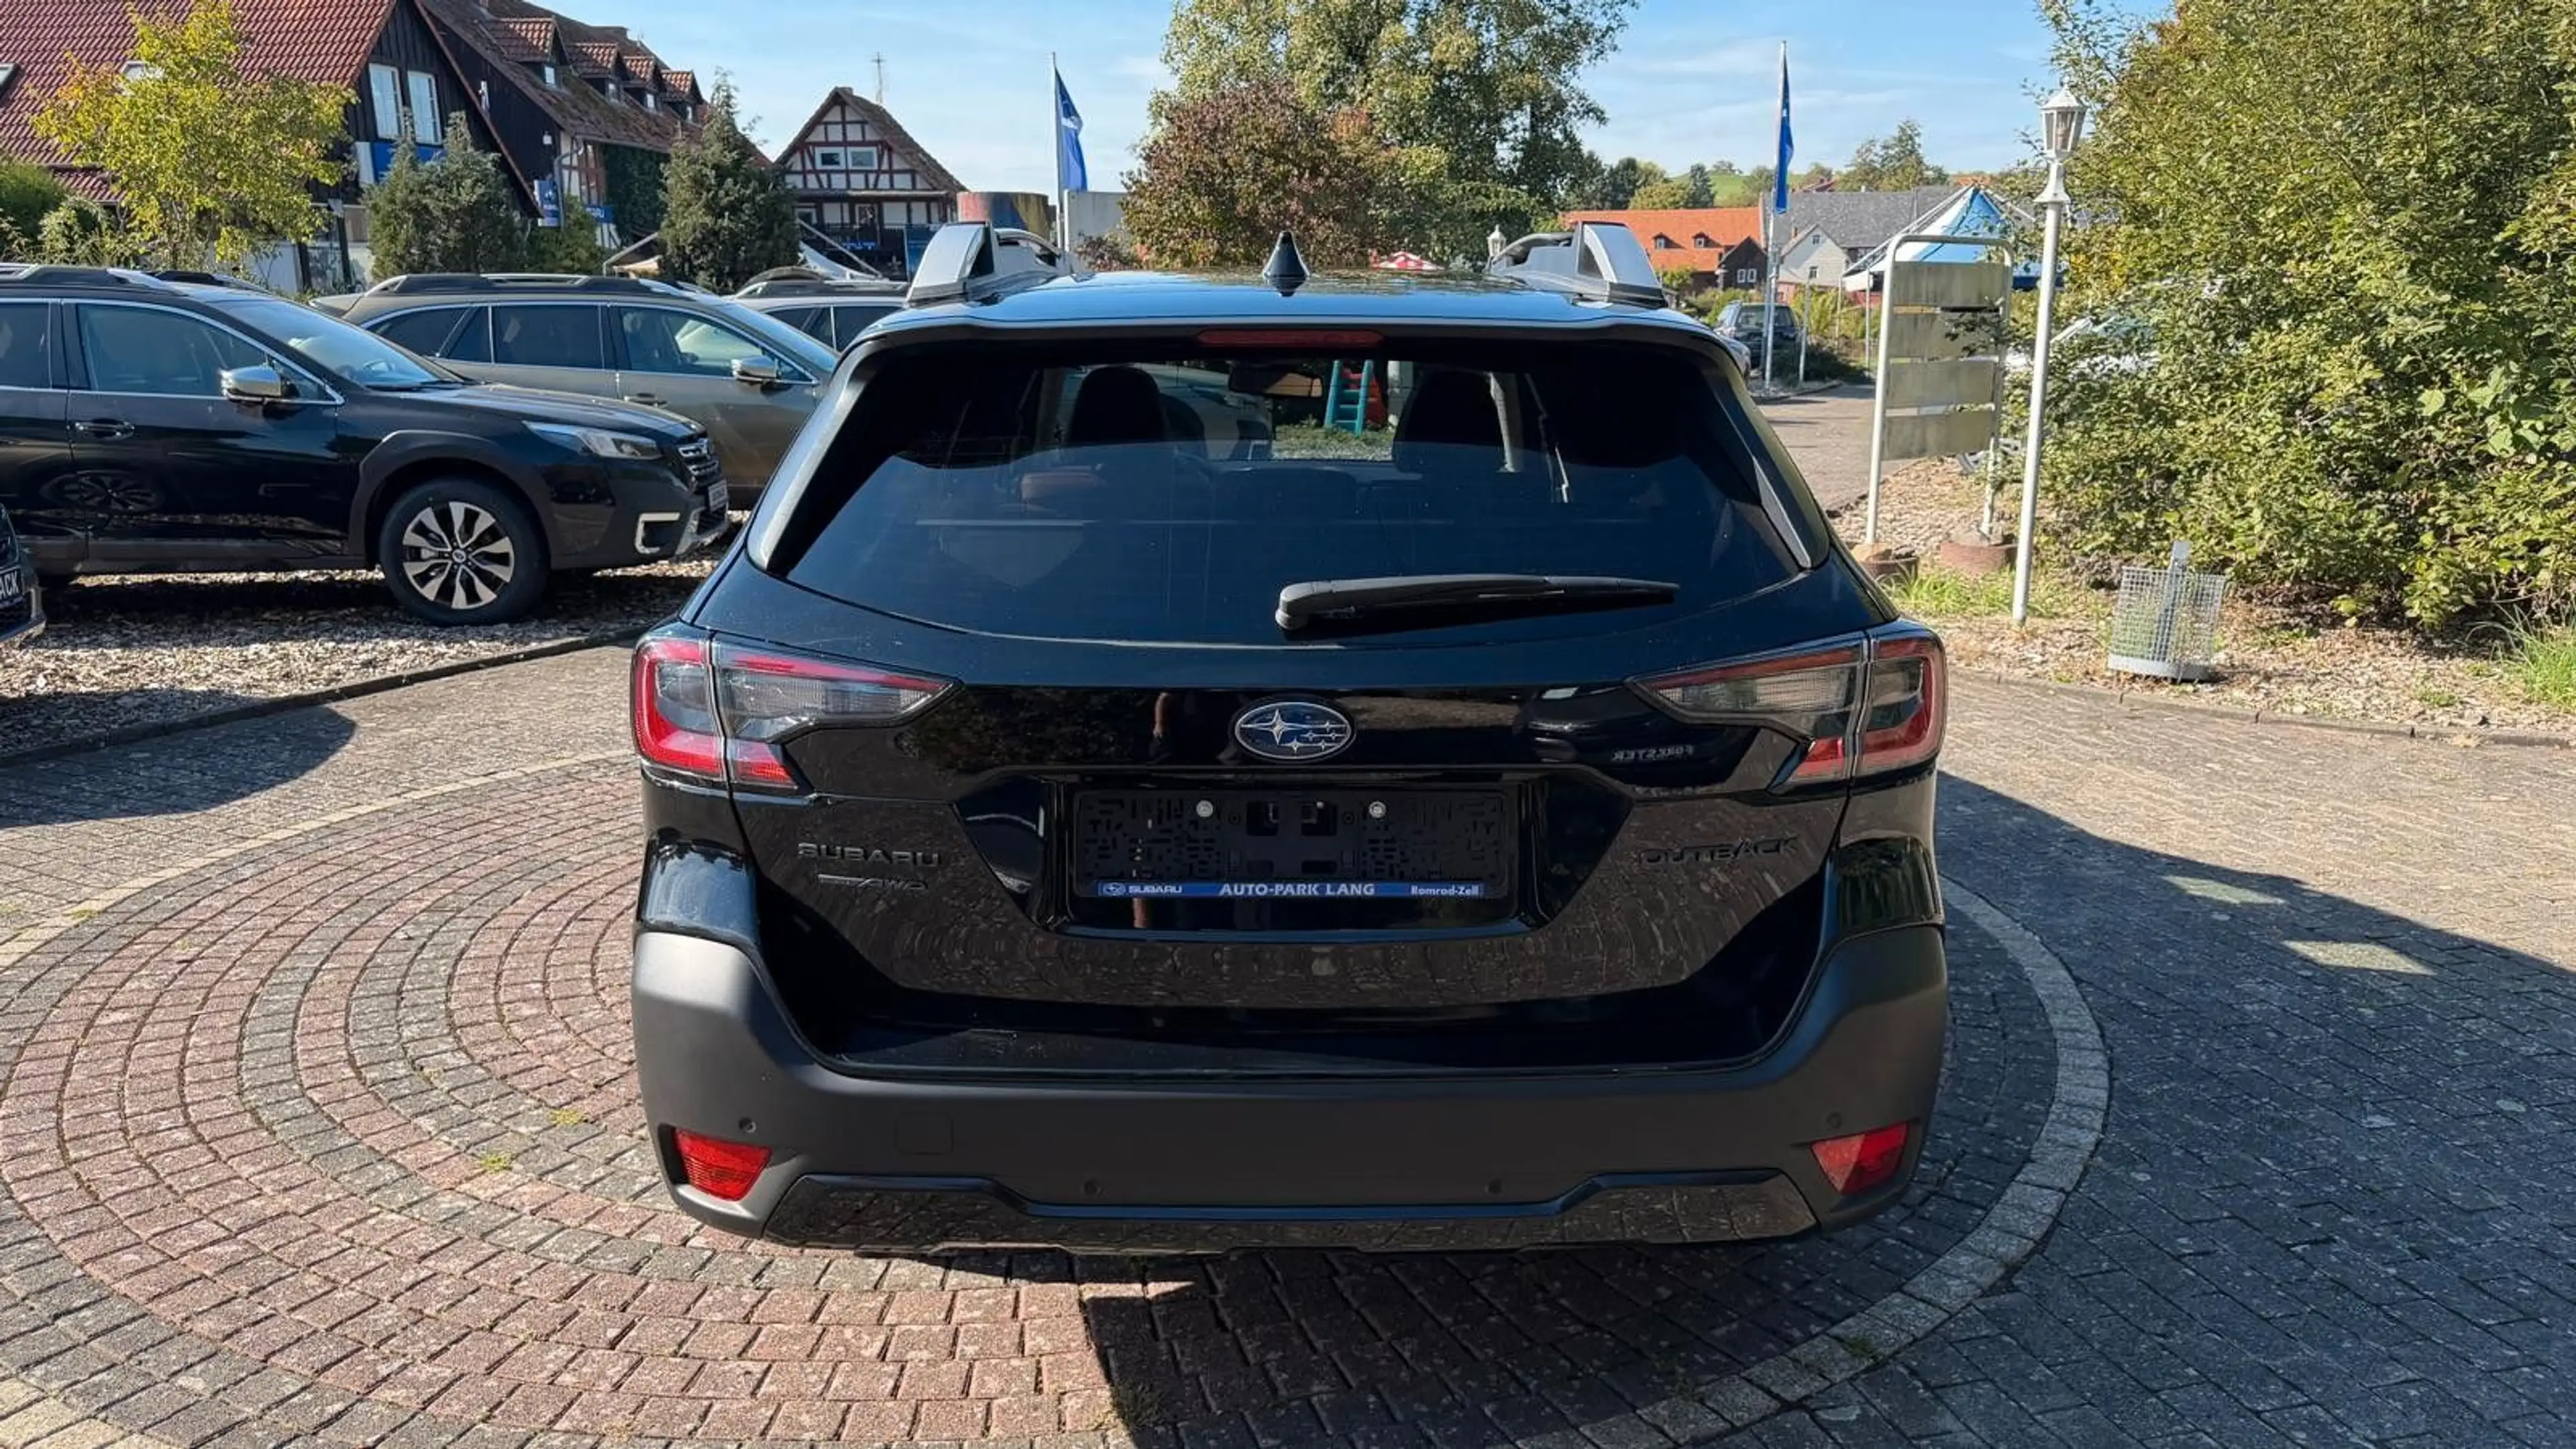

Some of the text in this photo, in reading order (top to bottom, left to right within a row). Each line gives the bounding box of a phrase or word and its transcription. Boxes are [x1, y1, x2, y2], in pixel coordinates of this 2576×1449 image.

[798, 843, 940, 867] SUBARU
[1640, 837, 1799, 864] OUTBACK
[1129, 884, 1183, 894] SUBARU
[1219, 883, 1375, 896] AUTO-PARK LANG
